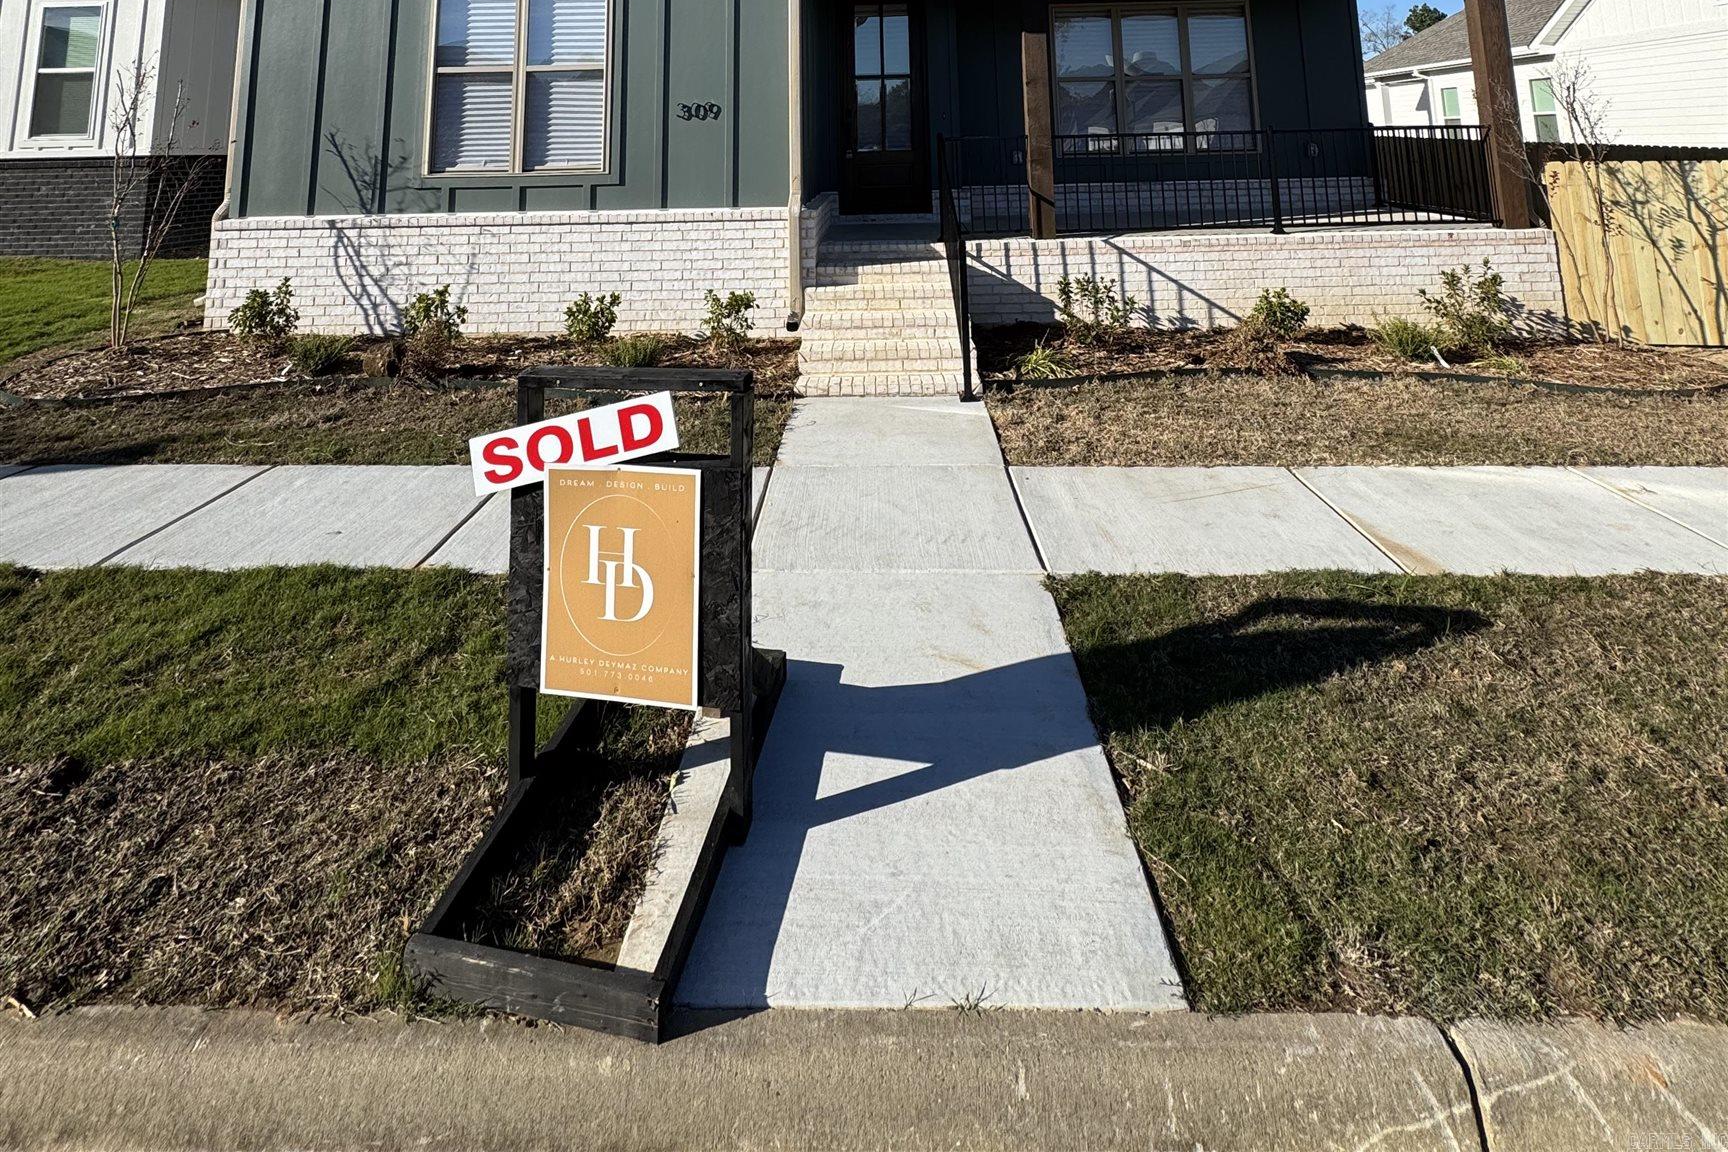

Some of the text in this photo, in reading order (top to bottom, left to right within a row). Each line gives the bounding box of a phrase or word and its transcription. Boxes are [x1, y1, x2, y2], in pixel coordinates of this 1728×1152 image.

[676, 101, 722, 121] 309
[482, 403, 664, 484] SOLD
[559, 479, 685, 492] DREAM DESIGN BUILD
[559, 655, 595, 665] HURLEY
[598, 660, 638, 671] DEYMAZ
[641, 664, 689, 676] COMPANY
